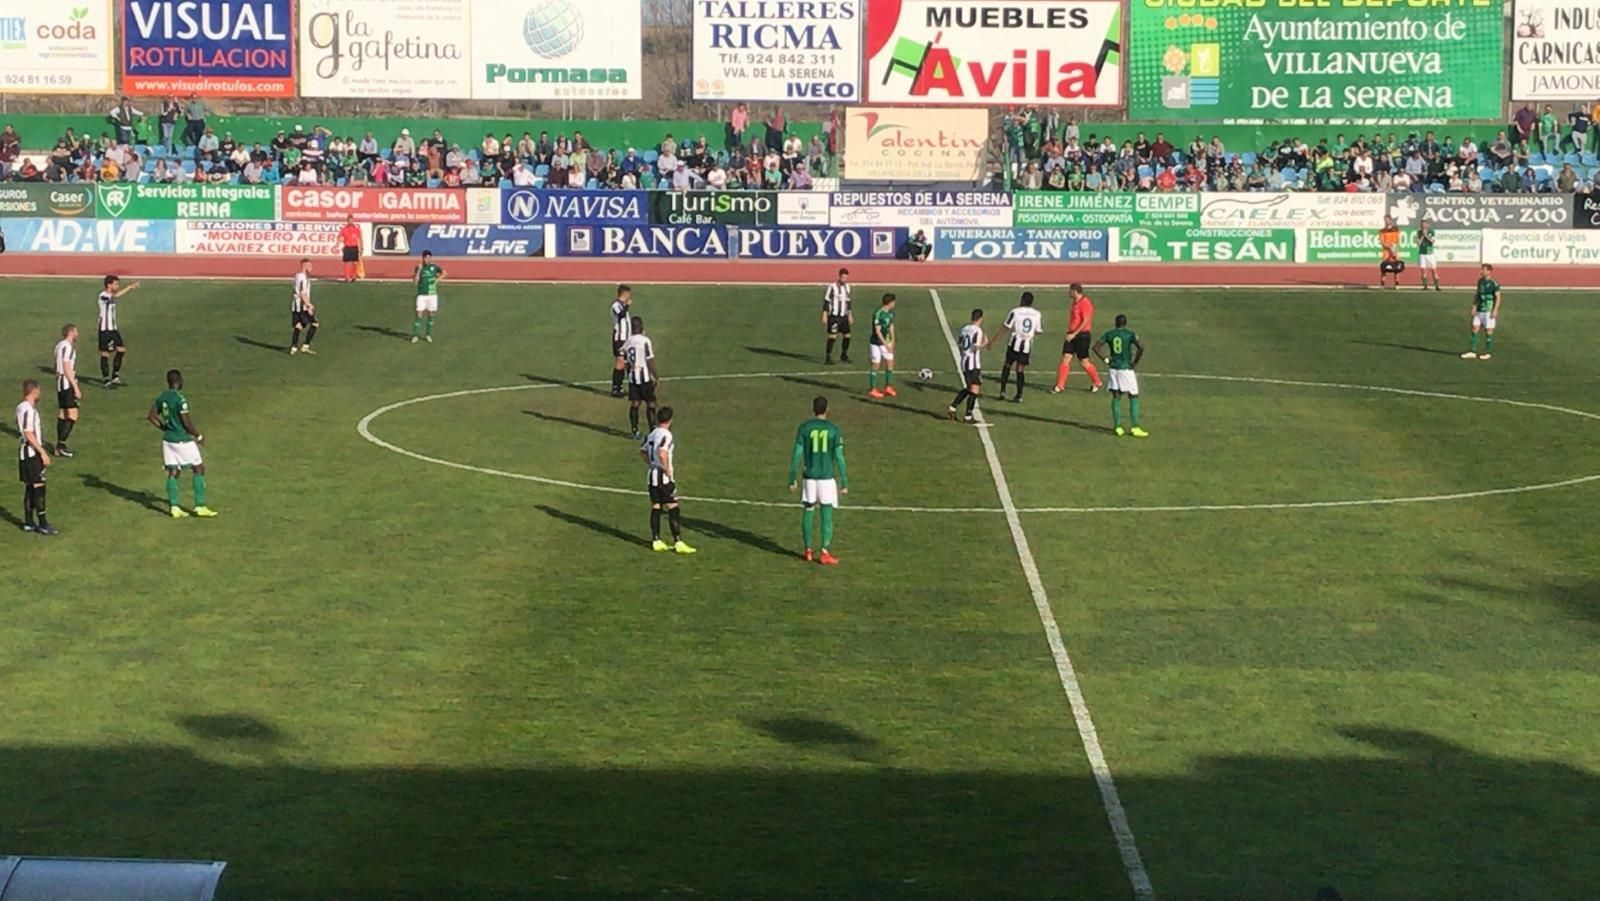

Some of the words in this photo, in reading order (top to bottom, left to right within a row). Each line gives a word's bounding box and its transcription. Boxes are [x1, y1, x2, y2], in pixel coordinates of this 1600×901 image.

[702, 0, 854, 19] TALLERES
[926, 7, 1088, 28] MUEBLES
[130, 2, 286, 41] VISUAL
[345, 10, 373, 37] la
[1242, 12, 1428, 48] Ayuntamiento
[1440, 13, 1467, 41] de
[37, 21, 96, 40] coda
[710, 23, 842, 50] RICMA
[131, 47, 286, 69] ROTULACION
[349, 31, 462, 71] gafetina
[746, 53, 773, 65] 924
[778, 53, 805, 65] 842
[810, 53, 835, 65] 311
[486, 63, 628, 83] Pormasa
[751, 67, 768, 79] DE
[770, 67, 786, 79] LA
[788, 67, 835, 79] SERENA
[912, 31, 1097, 98] Ávila
[5, 74, 25, 84] 924
[27, 75, 40, 84] 81
[44, 75, 57, 85] 16
[59, 75, 72, 85] 59
[135, 80, 285, 93] www.visualrotulos.com
[787, 81, 854, 98] IVECO
[50, 191, 84, 203] Caser
[137, 184, 197, 199] Servicios
[202, 185, 271, 200] Integrales
[288, 189, 364, 208] casor
[834, 194, 912, 206] REPUESTOS
[914, 195, 931, 206] DE
[936, 195, 954, 206] LA
[956, 195, 1010, 207] SERENA
[177, 201, 231, 218] REINA
[544, 195, 640, 219] NAVISA
[666, 191, 771, 213] Turismo
[1019, 195, 1065, 208] IRENE
[1067, 193, 1133, 209] JIMÉNEZ
[1137, 196, 1194, 210] CEMPE
[1425, 196, 1475, 205] CENTRO
[1480, 196, 1564, 206] VETERINARIO
[668, 213, 692, 224] Café
[897, 209, 943, 217] RECAMBIOS
[944, 209, 951, 217] Y
[951, 209, 1001, 217] ACCESORIOS
[920, 217, 934, 225] DEL
[1017, 212, 1075, 224] FISIOTERAPIA
[1082, 211, 1134, 224] OSTEOPATÍA
[1207, 208, 1327, 220] CAELEX
[1423, 207, 1500, 226] ACQUA
[1520, 207, 1567, 223] ZOO
[187, 222, 273, 231] ESTACIONES
[275, 223, 292, 231] DE
[297, 224, 345, 232] SERVIC
[426, 224, 488, 238] PUNTO
[940, 229, 1015, 239] FUNERARIA
[1026, 229, 1103, 240] TANATORIO
[1186, 229, 1272, 238] CONSTRUCCIONES
[29, 220, 149, 252] ADAME
[207, 231, 293, 241] MONEDERO
[602, 227, 726, 255] BANCA
[739, 229, 862, 257] PUEYO
[1310, 231, 1381, 248] Heineke
[1501, 231, 1541, 244] Agencia
[1543, 231, 1555, 241] de
[1557, 231, 1587, 244] Viajes
[196, 242, 264, 252] ALVAREZ
[268, 243, 341, 254] CIENFUEG
[467, 239, 529, 254] LLAVE
[951, 241, 1064, 258] LOLIN
[1167, 237, 1287, 260] TESÁN
[1500, 244, 1561, 261] Century
[1022, 317, 1033, 333] 9
[1112, 336, 1122, 353] 8
[628, 346, 637, 363] 8
[810, 430, 829, 453] 11
